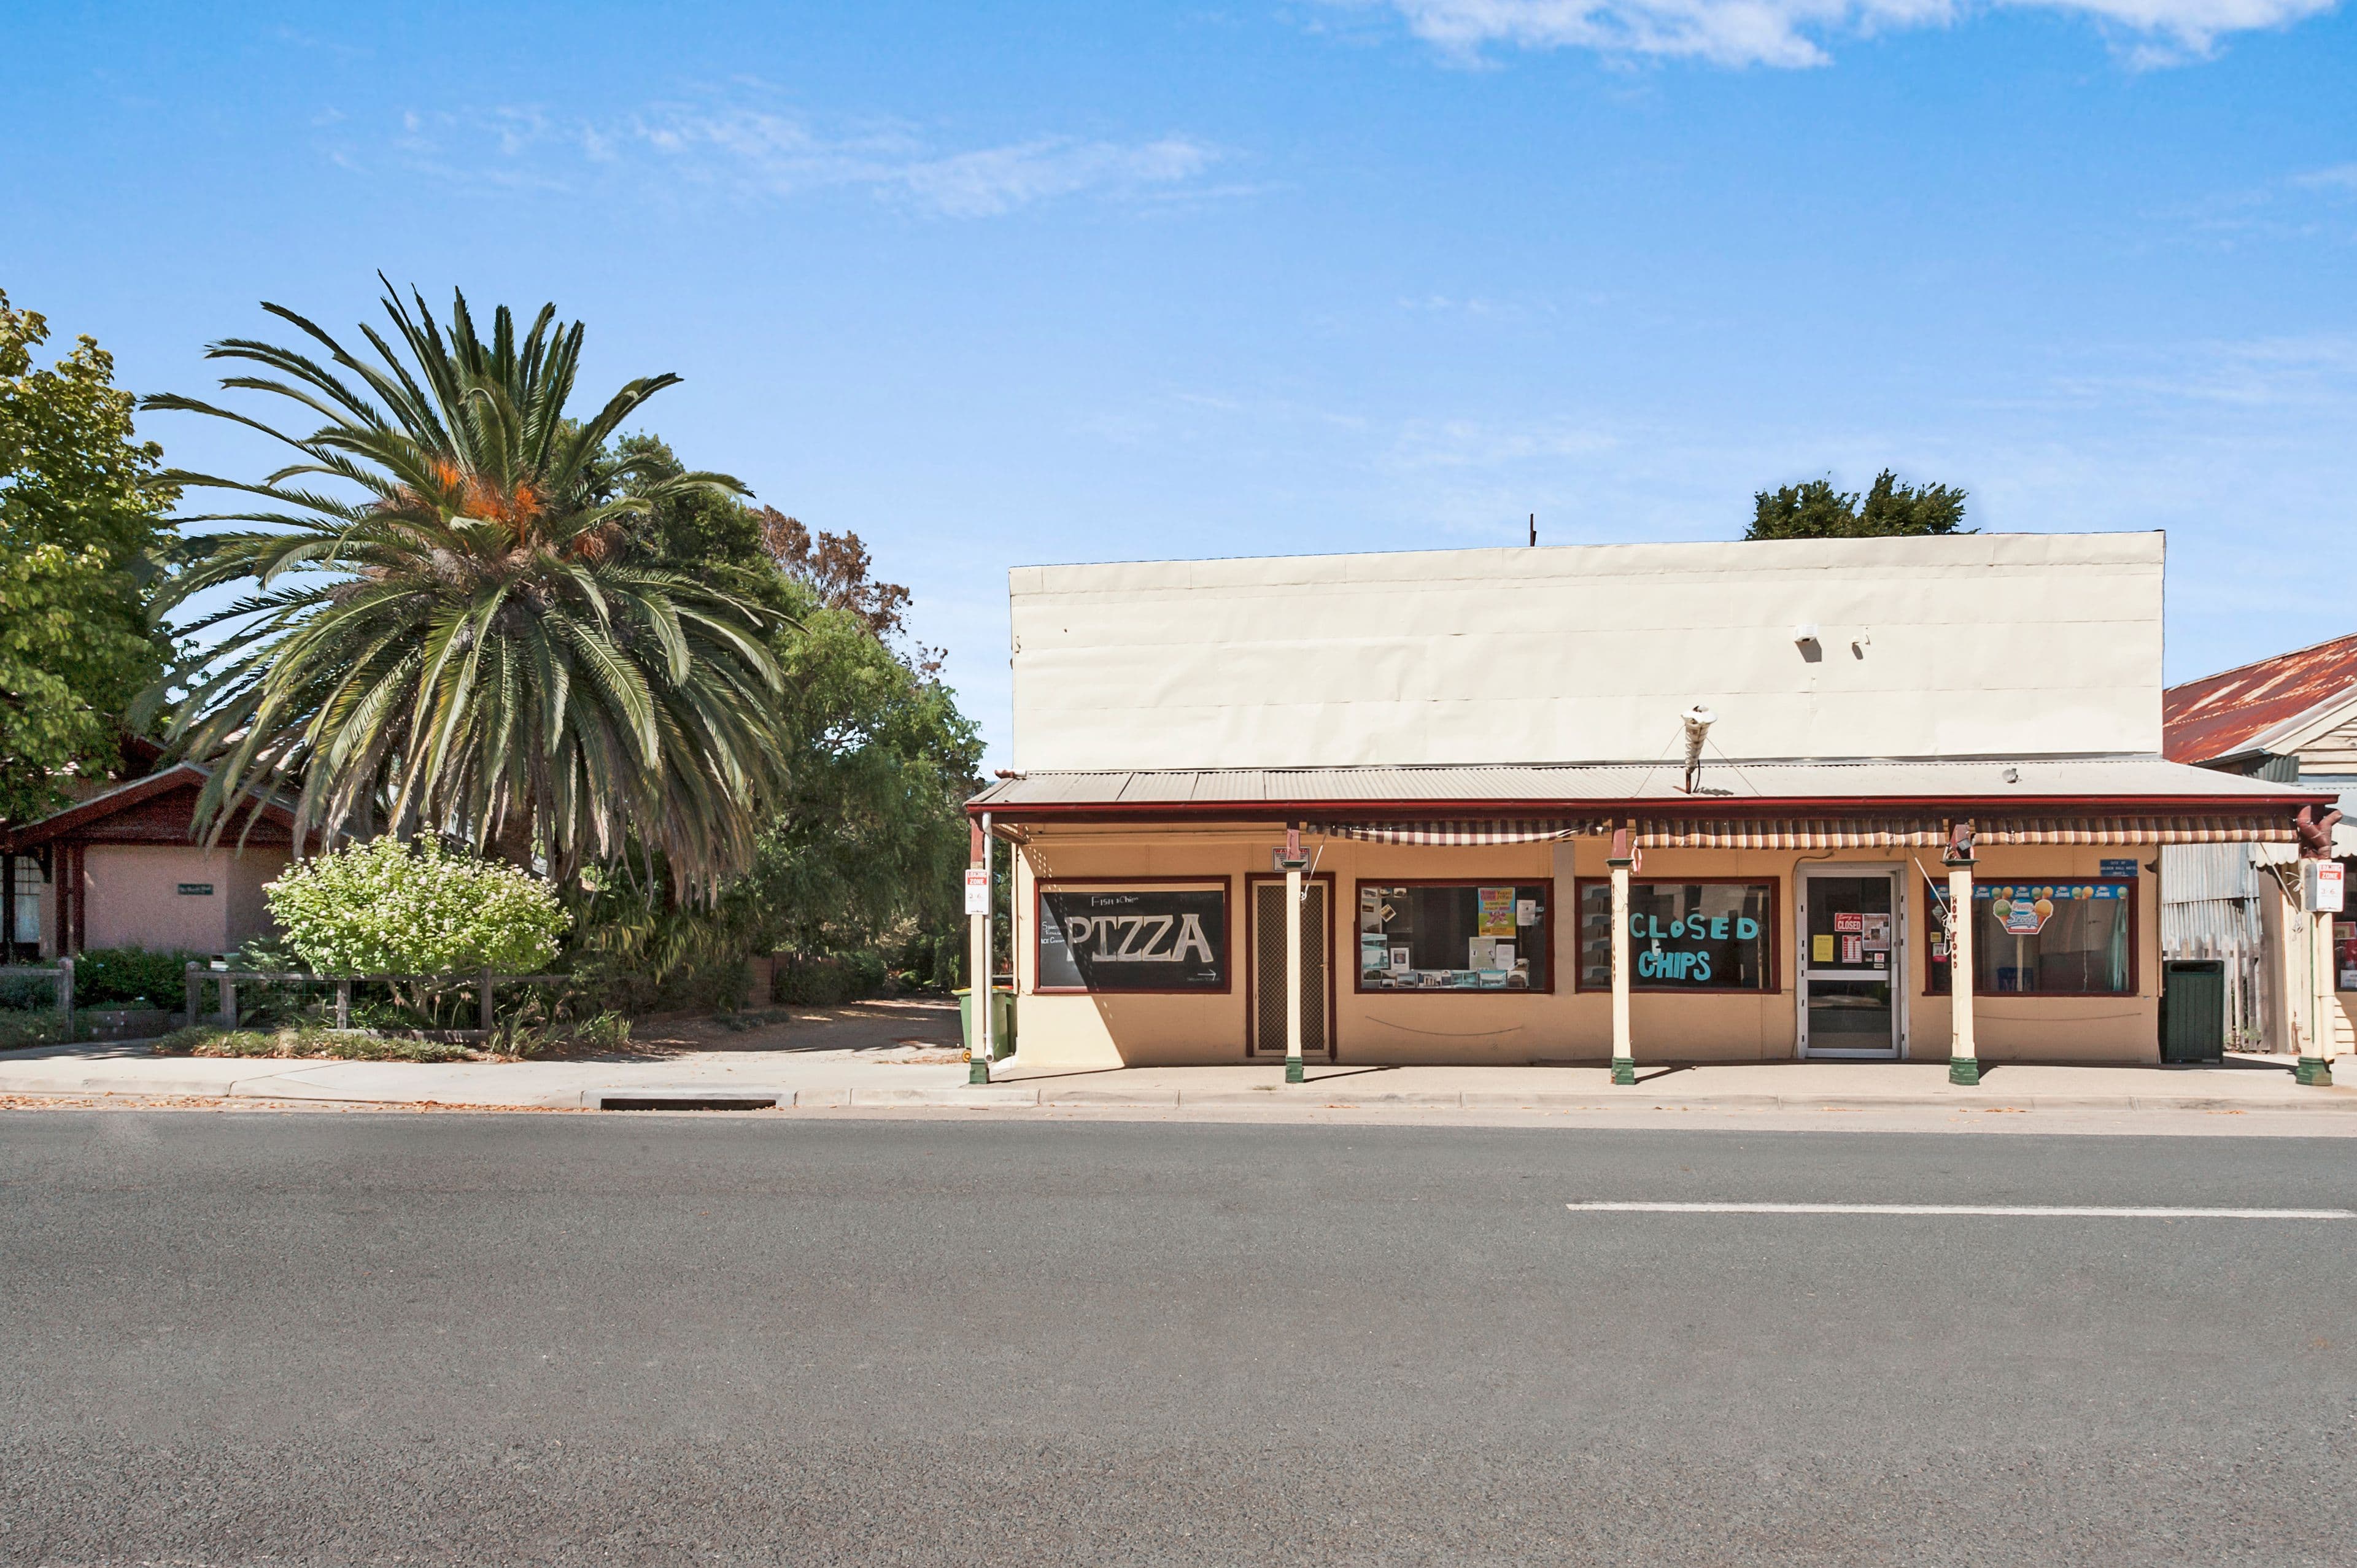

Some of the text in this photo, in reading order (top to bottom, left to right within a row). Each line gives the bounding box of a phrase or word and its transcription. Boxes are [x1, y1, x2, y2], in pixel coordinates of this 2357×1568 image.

[1064, 913, 1213, 963] PIZZA
[1630, 913, 1759, 940] CLOSED
[1838, 921, 1860, 930] CLOSED
[1639, 951, 1711, 981] CHIPS
